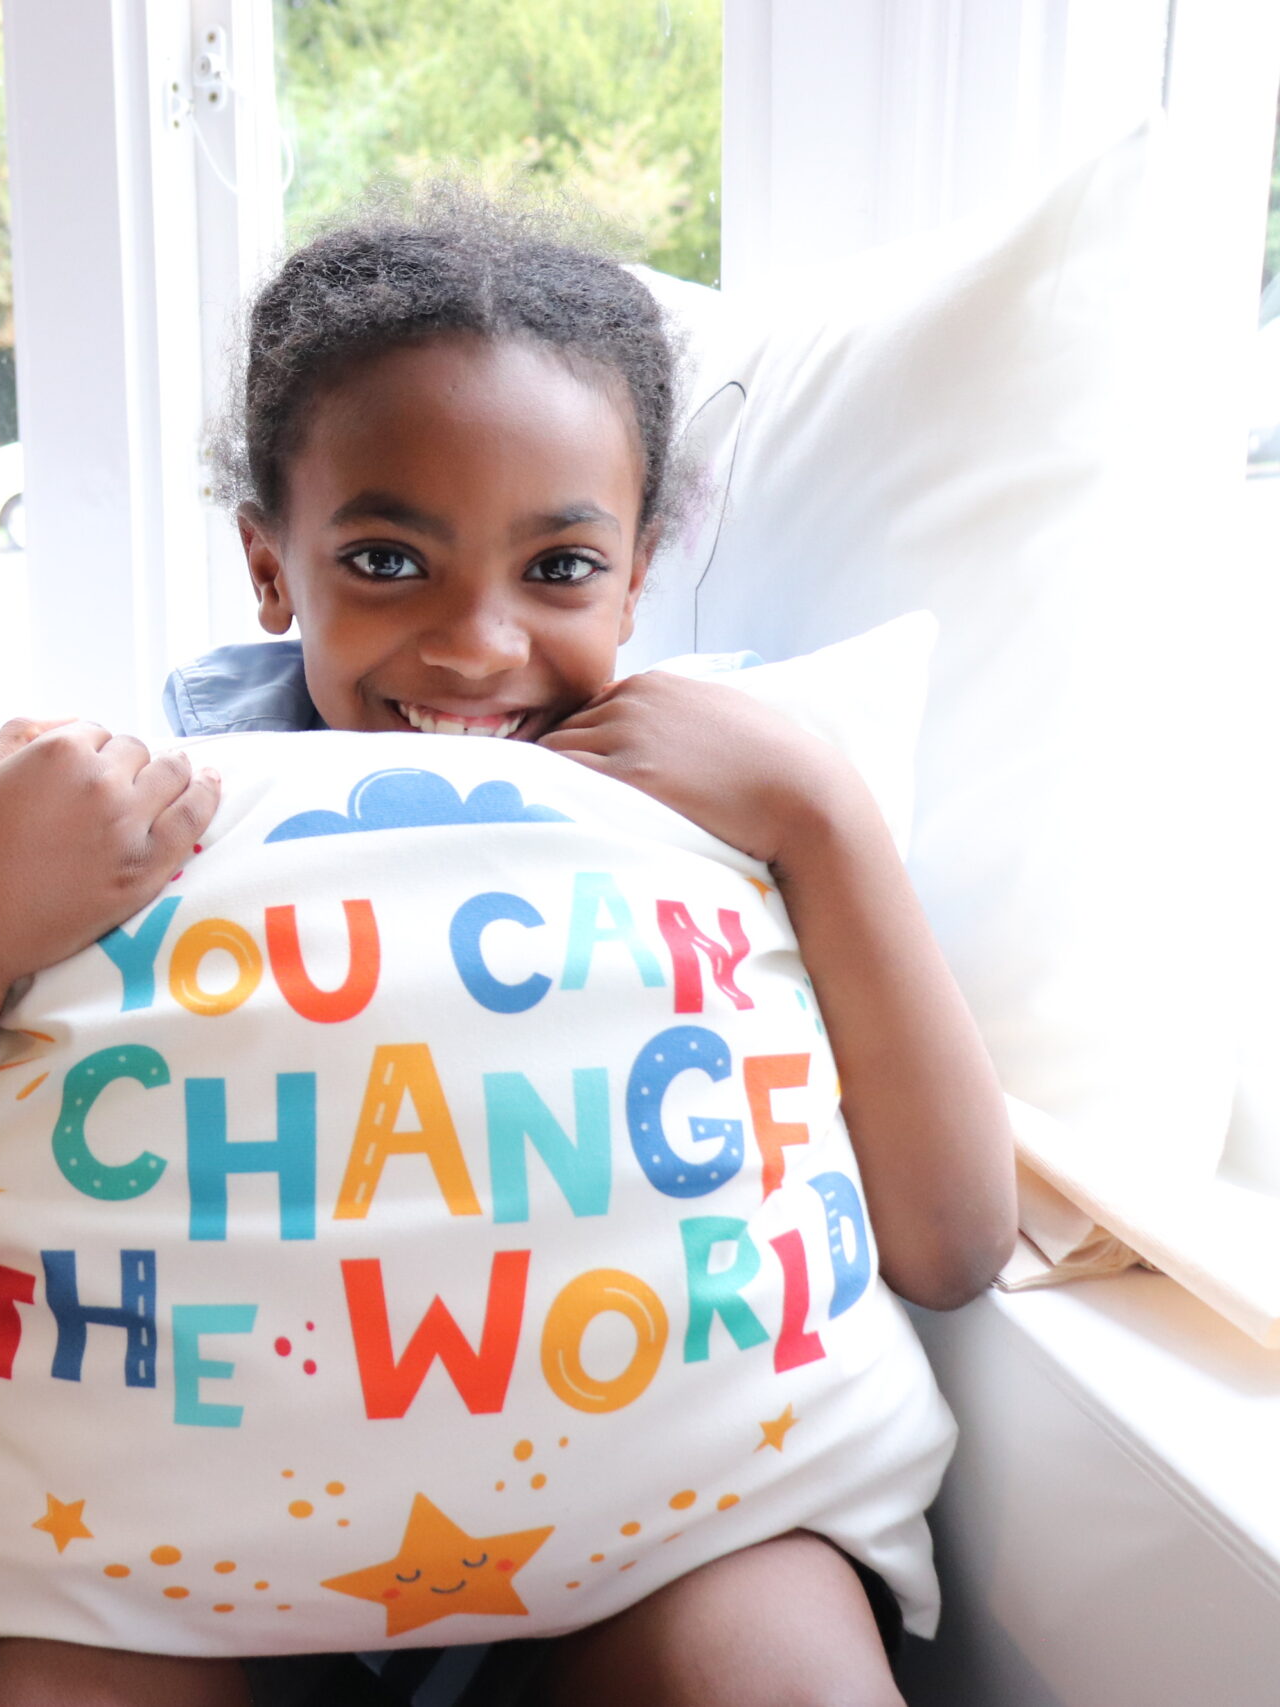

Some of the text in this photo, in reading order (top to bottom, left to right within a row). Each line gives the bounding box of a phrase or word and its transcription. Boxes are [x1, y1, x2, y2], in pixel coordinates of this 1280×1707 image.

[96, 871, 756, 1024] YOU CAN
[339, 1170, 871, 1421] WORLD
